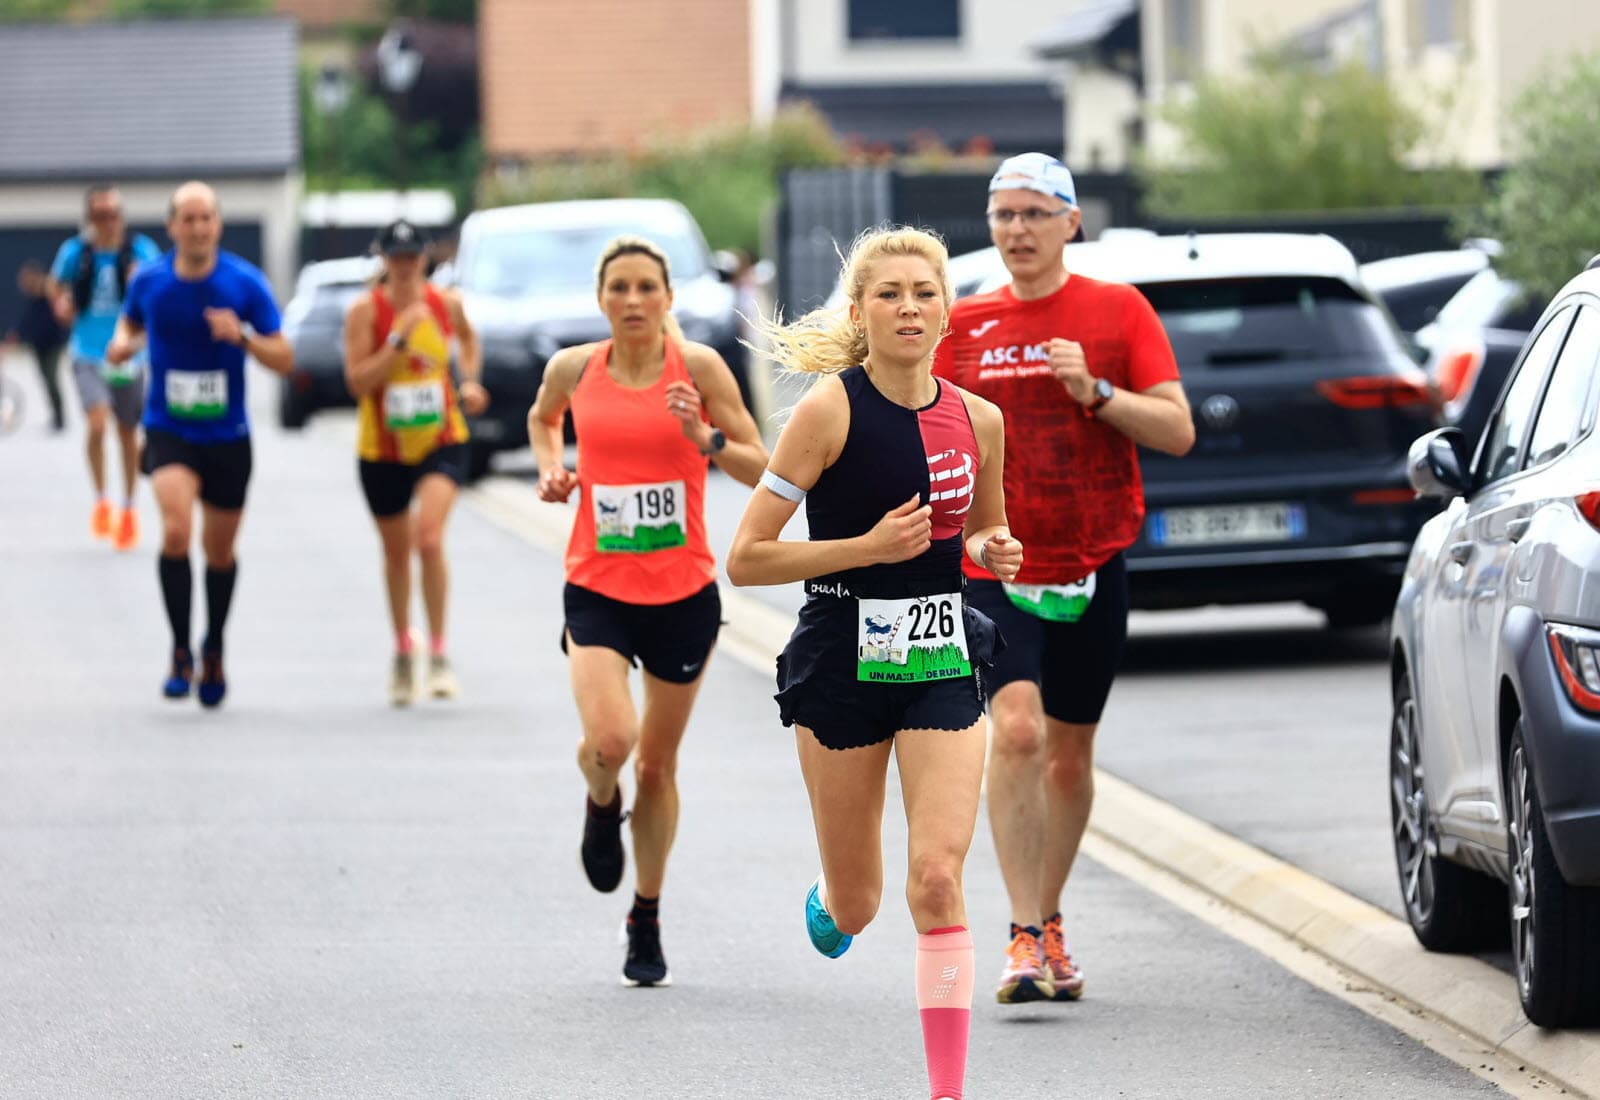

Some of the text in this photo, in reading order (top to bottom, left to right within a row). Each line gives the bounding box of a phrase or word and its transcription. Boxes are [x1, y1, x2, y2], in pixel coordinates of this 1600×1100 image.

[980, 345, 1019, 367] ASC
[635, 487, 675, 519] 198
[908, 600, 954, 641] 226
[869, 672, 885, 680] UN
[926, 670, 938, 679] DE
[939, 667, 961, 677] RUN
